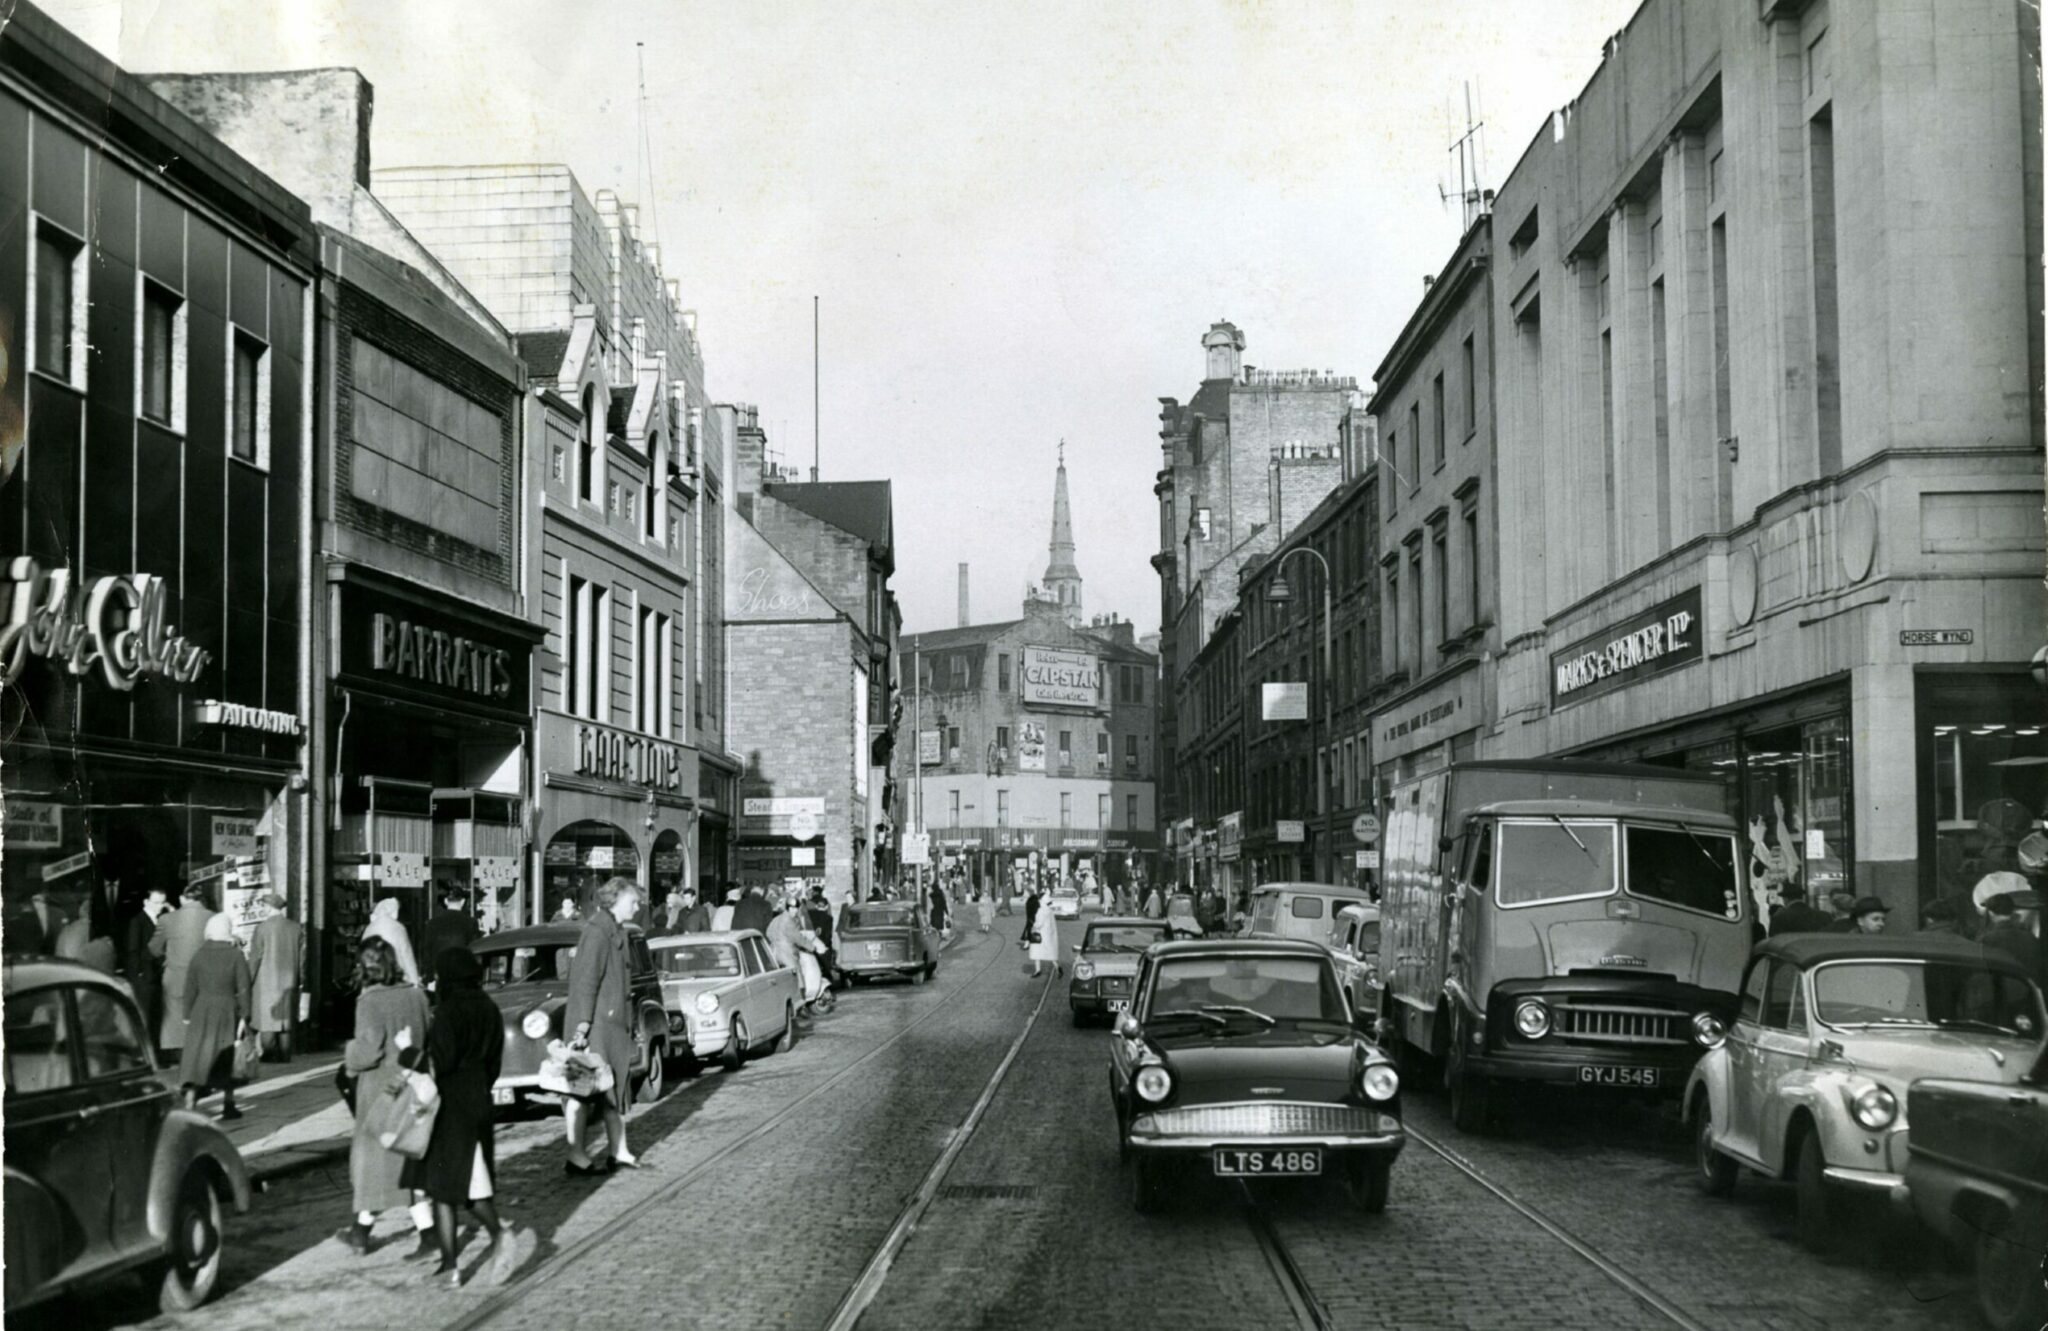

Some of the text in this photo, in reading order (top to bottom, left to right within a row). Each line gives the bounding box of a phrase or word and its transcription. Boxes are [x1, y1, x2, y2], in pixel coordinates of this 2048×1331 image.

[733, 567, 809, 616] Shoes
[86, 573, 213, 692] Collier
[1904, 631, 1969, 643] HORSE WYND
[373, 613, 511, 698] BARRATTS
[1556, 650, 1598, 696] MARKS
[1597, 654, 1608, 679] &
[1606, 622, 1666, 674] SPENCER
[1025, 667, 1100, 689] CAPSTAN
[747, 800, 772, 814] Stead
[1361, 819, 1375, 827] NO
[386, 864, 419, 880] SALE
[482, 867, 511, 881] SALE
[1581, 1066, 1655, 1085] GYJ 545
[1220, 1152, 1316, 1172] LTS 486
